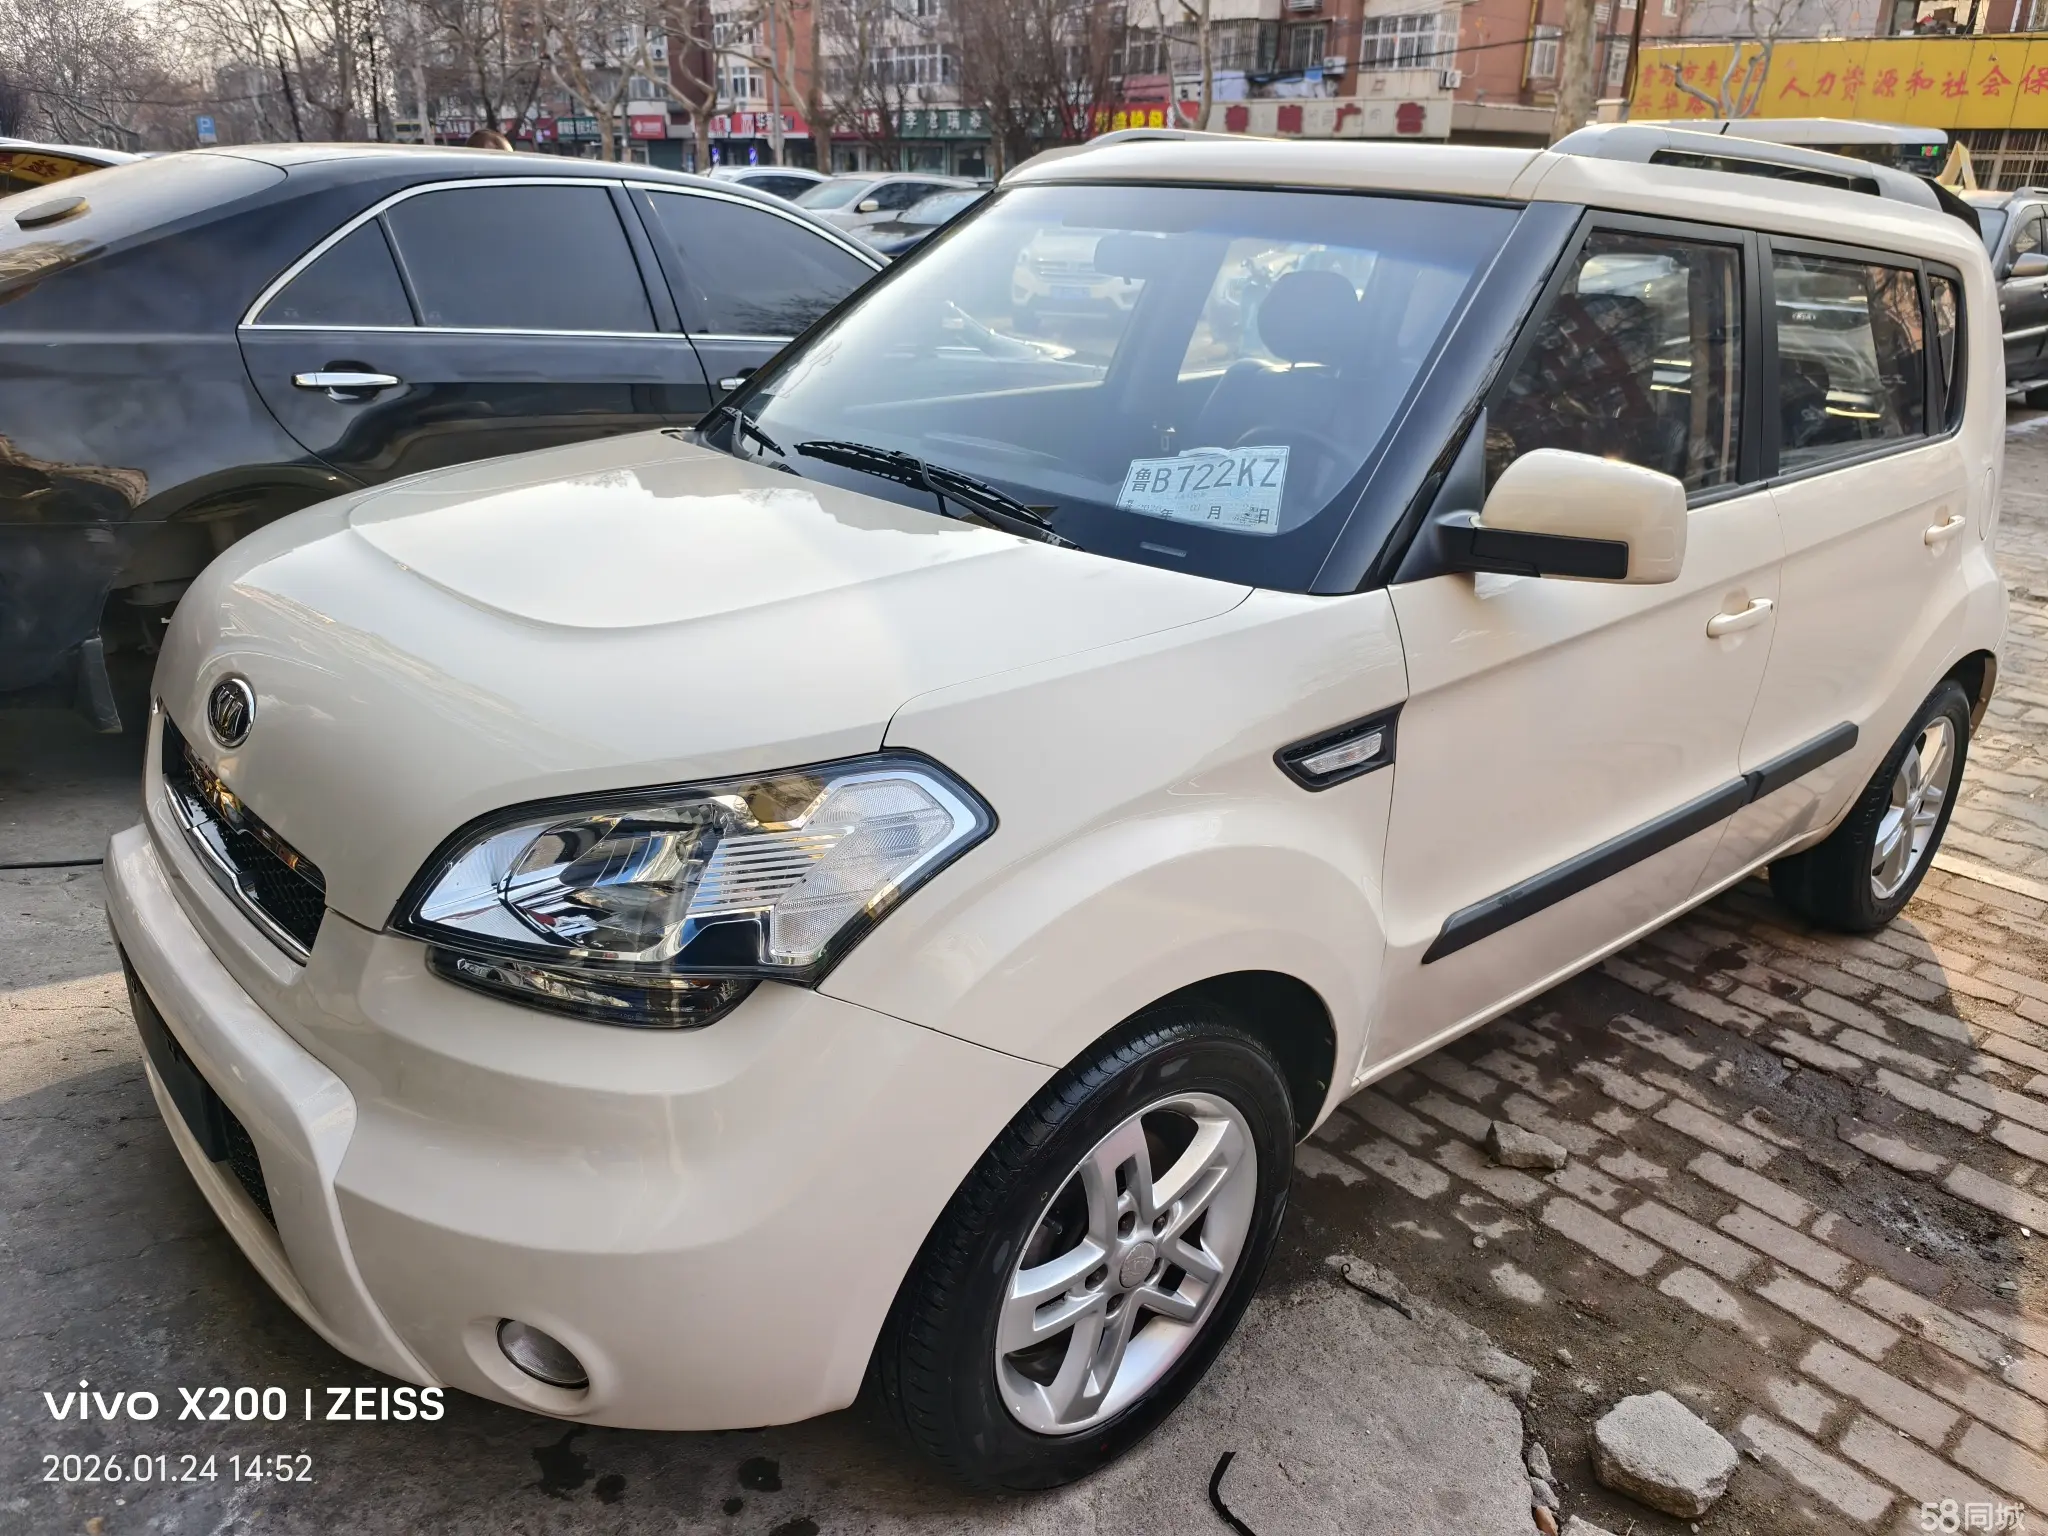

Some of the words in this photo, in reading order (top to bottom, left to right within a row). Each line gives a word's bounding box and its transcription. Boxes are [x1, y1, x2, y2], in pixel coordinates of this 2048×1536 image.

[1779, 64, 2048, 103] 人力资源和社会保
[1131, 458, 1280, 494] 鲁B722KZ
